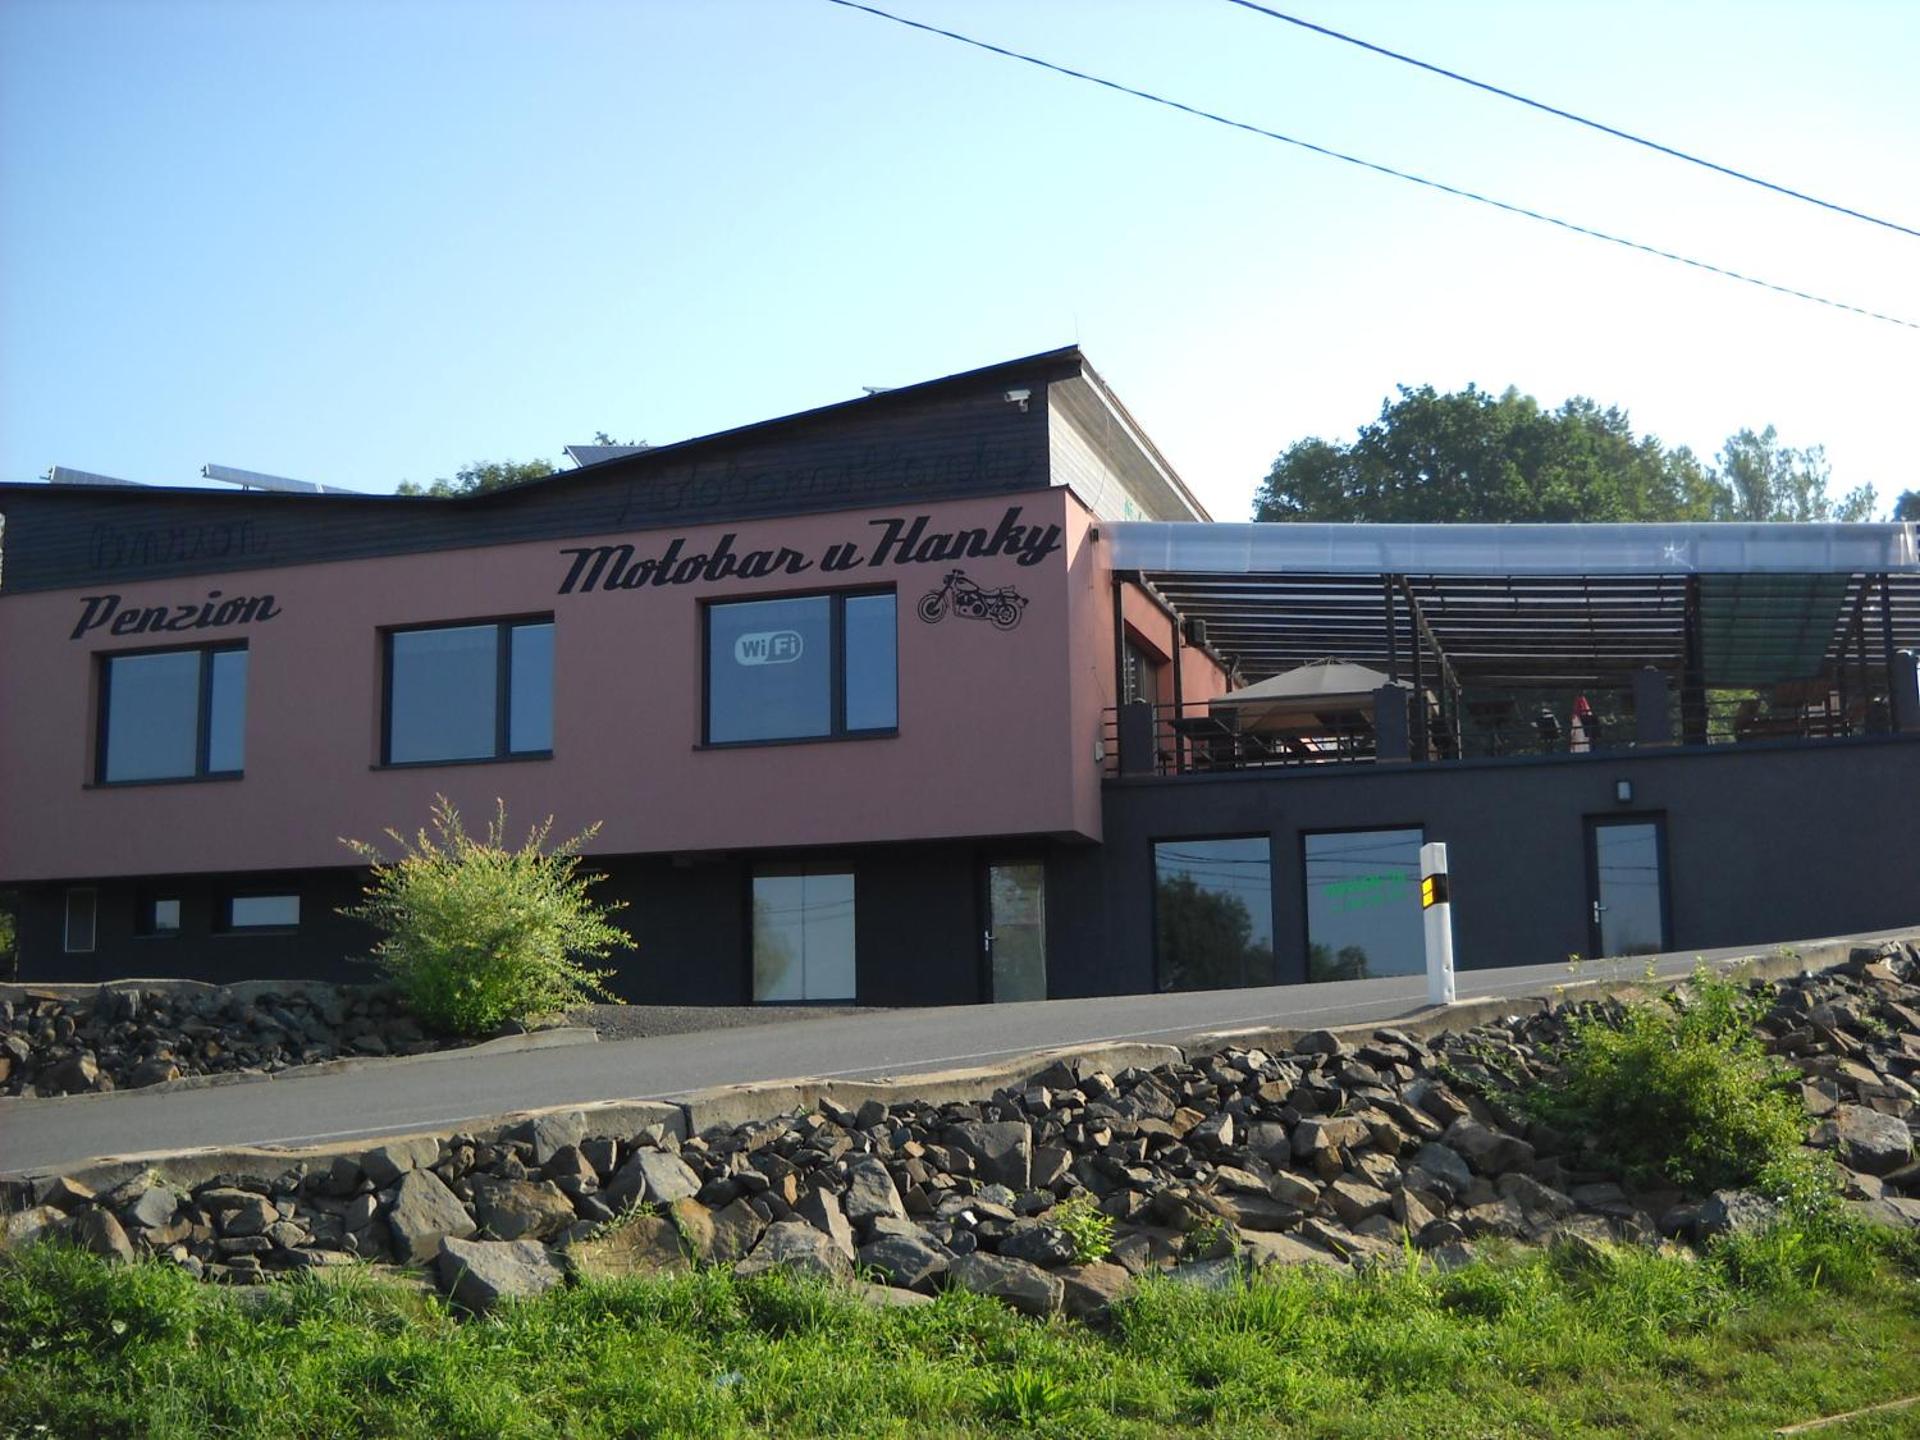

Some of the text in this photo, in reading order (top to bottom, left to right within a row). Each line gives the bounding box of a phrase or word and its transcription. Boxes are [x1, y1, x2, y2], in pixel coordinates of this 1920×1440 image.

[558, 506, 1061, 595] Motobar u Hanky
[70, 590, 282, 640] Penzion
